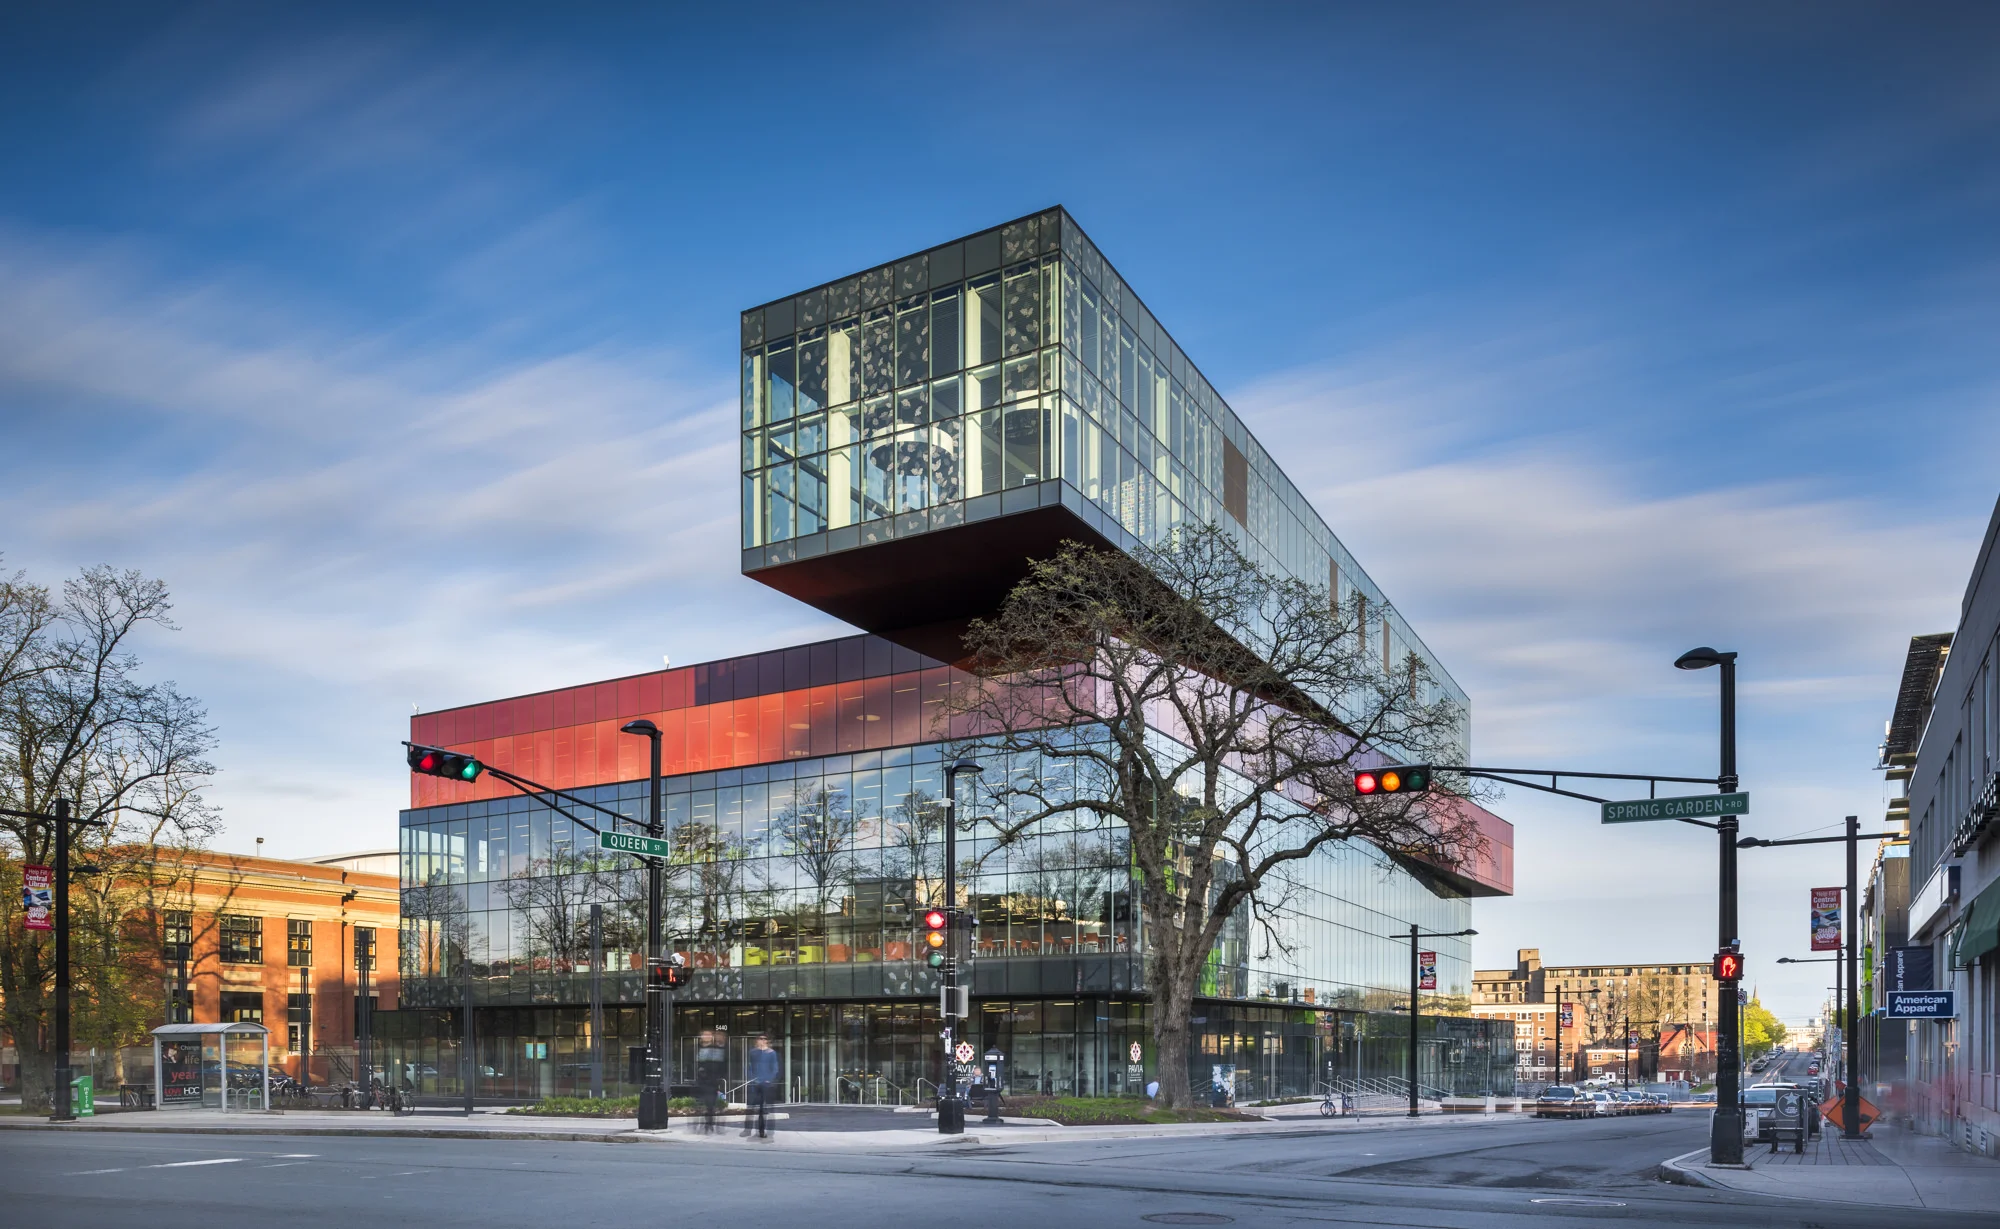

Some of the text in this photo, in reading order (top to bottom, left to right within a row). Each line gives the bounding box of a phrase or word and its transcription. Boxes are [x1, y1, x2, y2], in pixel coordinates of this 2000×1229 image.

[1608, 799, 1742, 819] SPRING GARDEN RD
[610, 835, 647, 851] QUEEN
[26, 874, 48, 882] Central
[1896, 950, 1905, 979] Apparel
[1894, 995, 1947, 1004] American
[1894, 1003, 1937, 1014] Apparel
[184, 1055, 200, 1065] life
[956, 1064, 976, 1073] AVI
[1128, 1064, 1144, 1073] PAVIA
